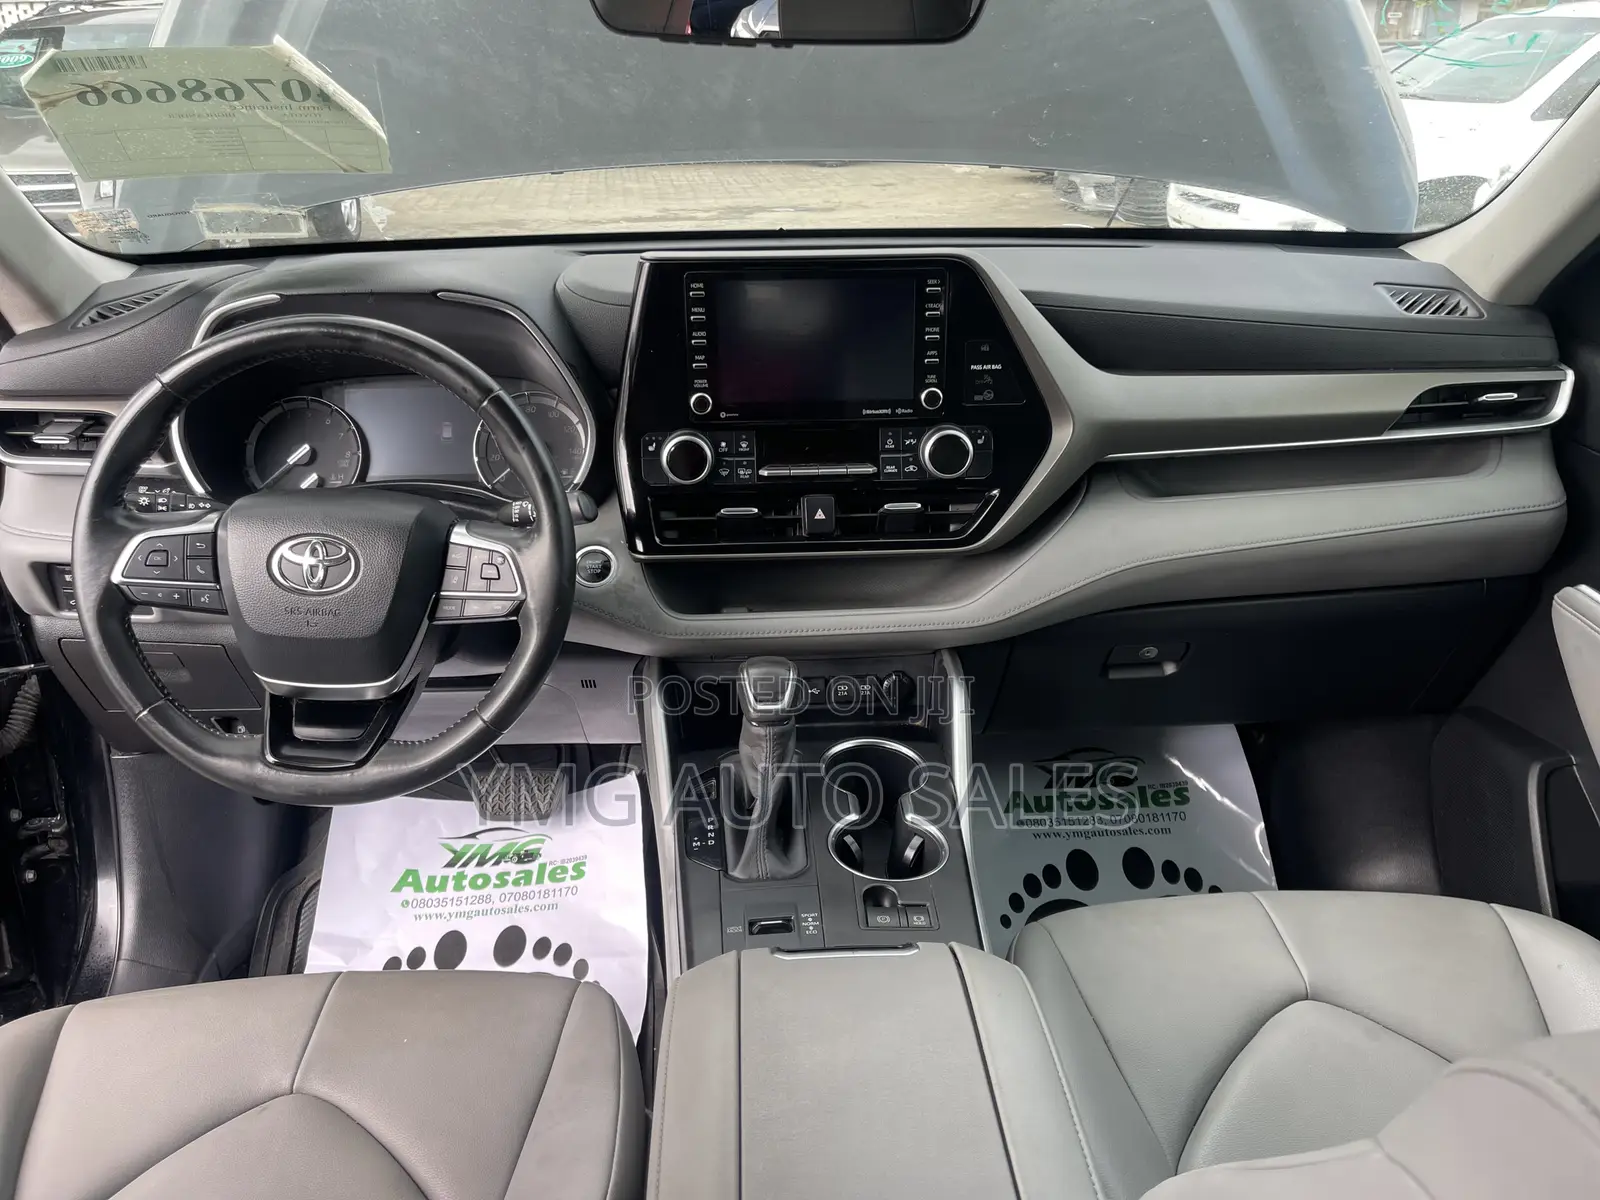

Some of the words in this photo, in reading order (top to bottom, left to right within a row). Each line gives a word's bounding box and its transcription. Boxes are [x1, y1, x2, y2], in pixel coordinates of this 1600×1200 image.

[284, 606, 302, 616] SRS
[305, 607, 341, 617] AIRBAG
[1004, 785, 1190, 814] Autosales
[1032, 826, 1172, 841] www.ymgautosales.com
[438, 837, 547, 869] YMG
[390, 861, 587, 894] Autosales
[499, 885, 579, 904] 07080181170
[413, 901, 559, 923] www.ymgautosales.com
